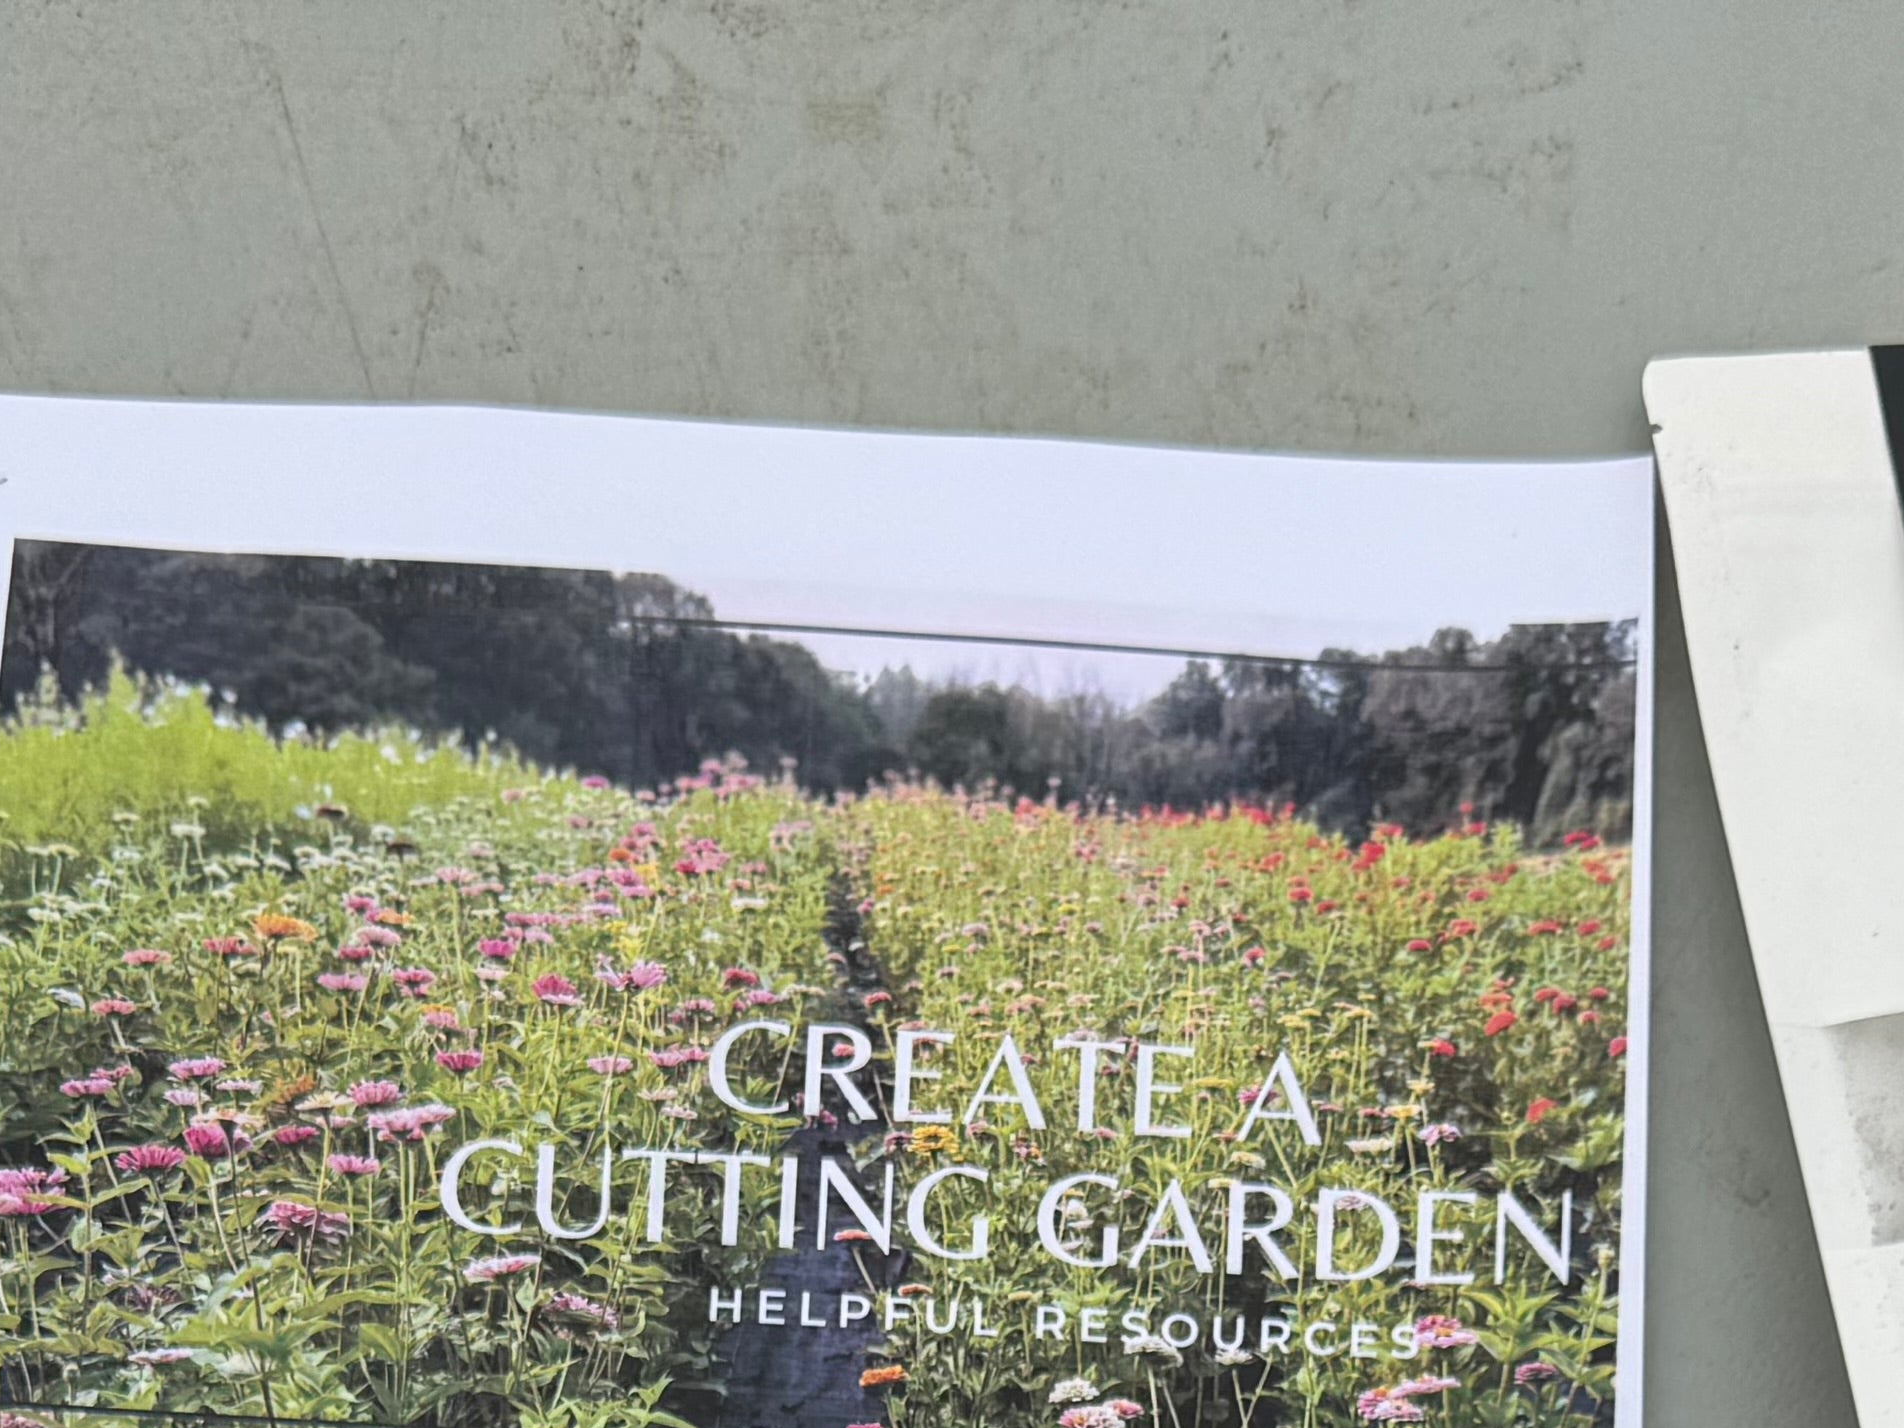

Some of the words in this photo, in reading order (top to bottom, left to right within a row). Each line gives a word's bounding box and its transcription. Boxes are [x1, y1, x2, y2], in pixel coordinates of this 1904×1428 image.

[708, 1019, 1195, 1140] CREATE
[1232, 1050, 1327, 1148] A
[439, 1138, 994, 1262] CUTTING
[1036, 1171, 1576, 1288] GARDEN
[707, 1284, 999, 1340] HELPFUL
[1035, 1304, 1423, 1363] RESOURCES
